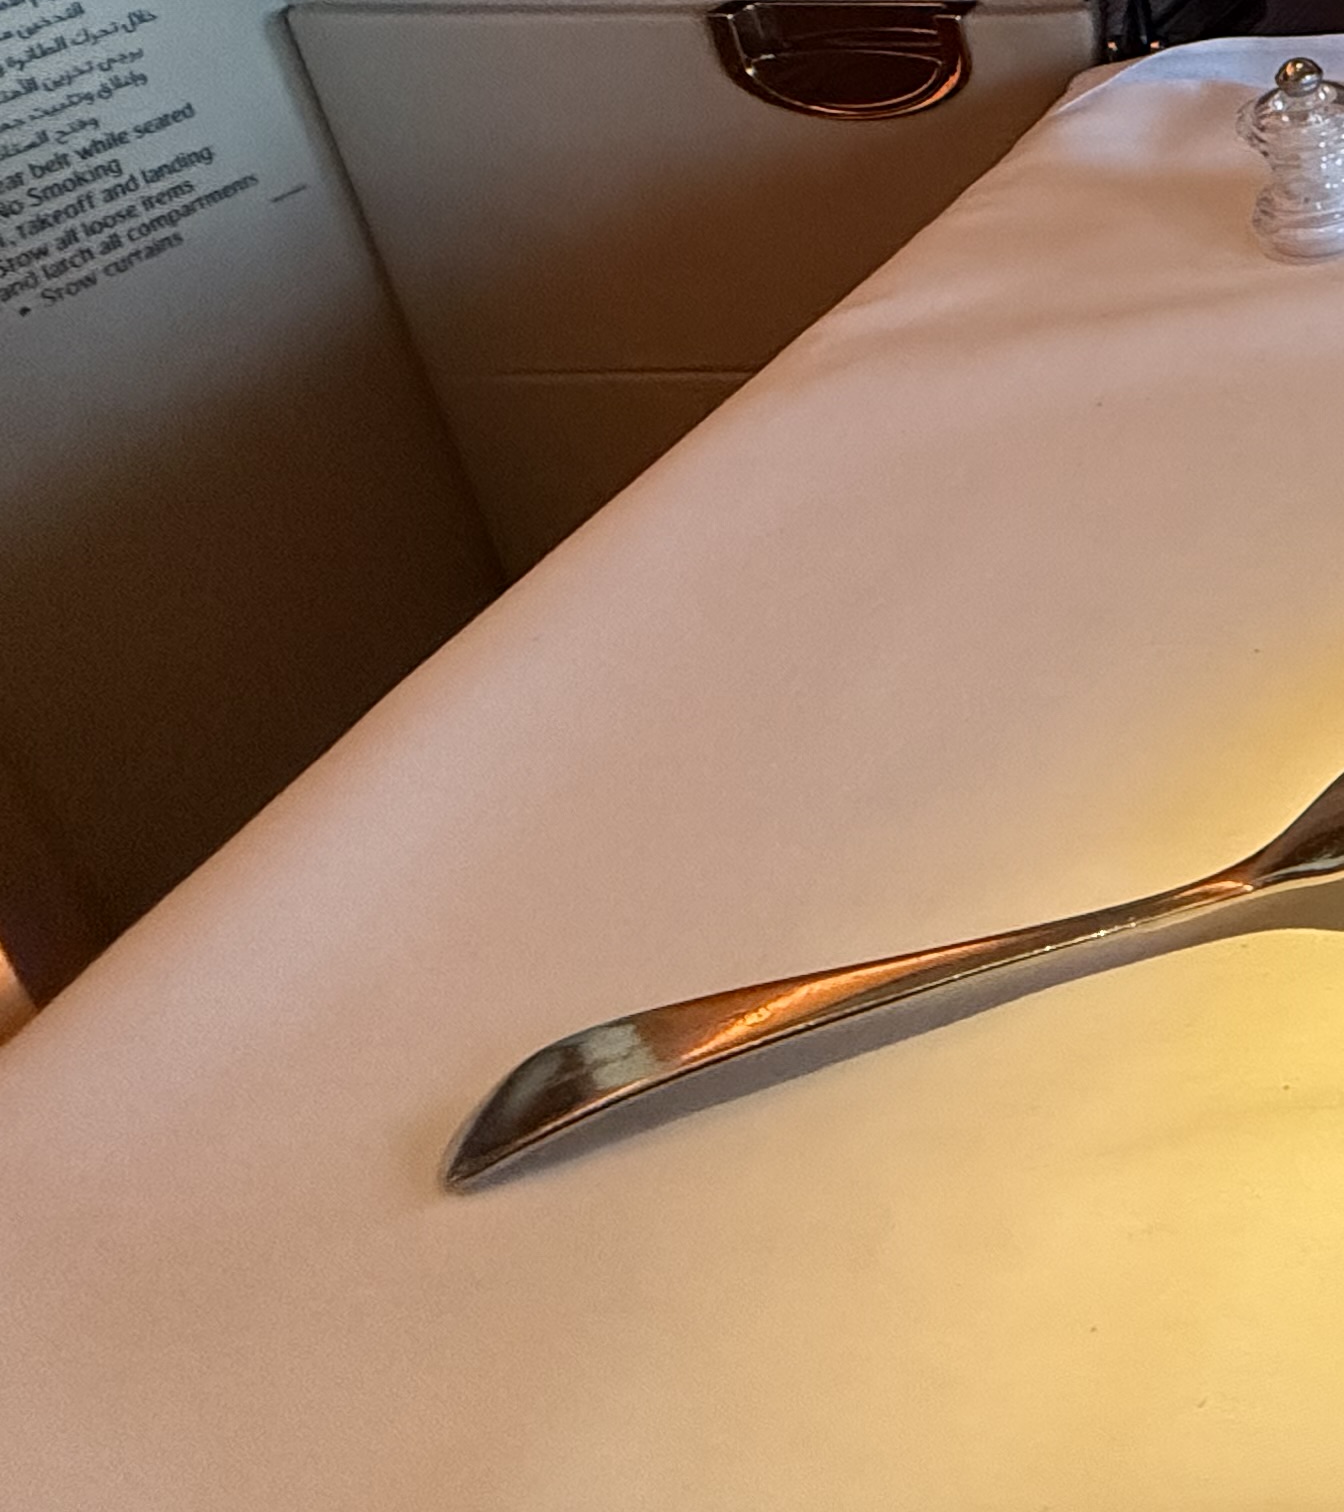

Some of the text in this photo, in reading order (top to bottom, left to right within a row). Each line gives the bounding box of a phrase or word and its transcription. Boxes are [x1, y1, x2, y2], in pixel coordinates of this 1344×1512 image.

[28, 153, 71, 178] belt
[74, 131, 131, 160] while
[133, 102, 195, 139] seated
[16, 147, 213, 239] takeoff and landing
[27, 159, 122, 207] Smoking
[57, 229, 80, 252] all
[81, 205, 139, 237] loose
[142, 180, 194, 212] items
[0, 173, 258, 302] and latch all compartments
[41, 231, 184, 304] Stow curtains
